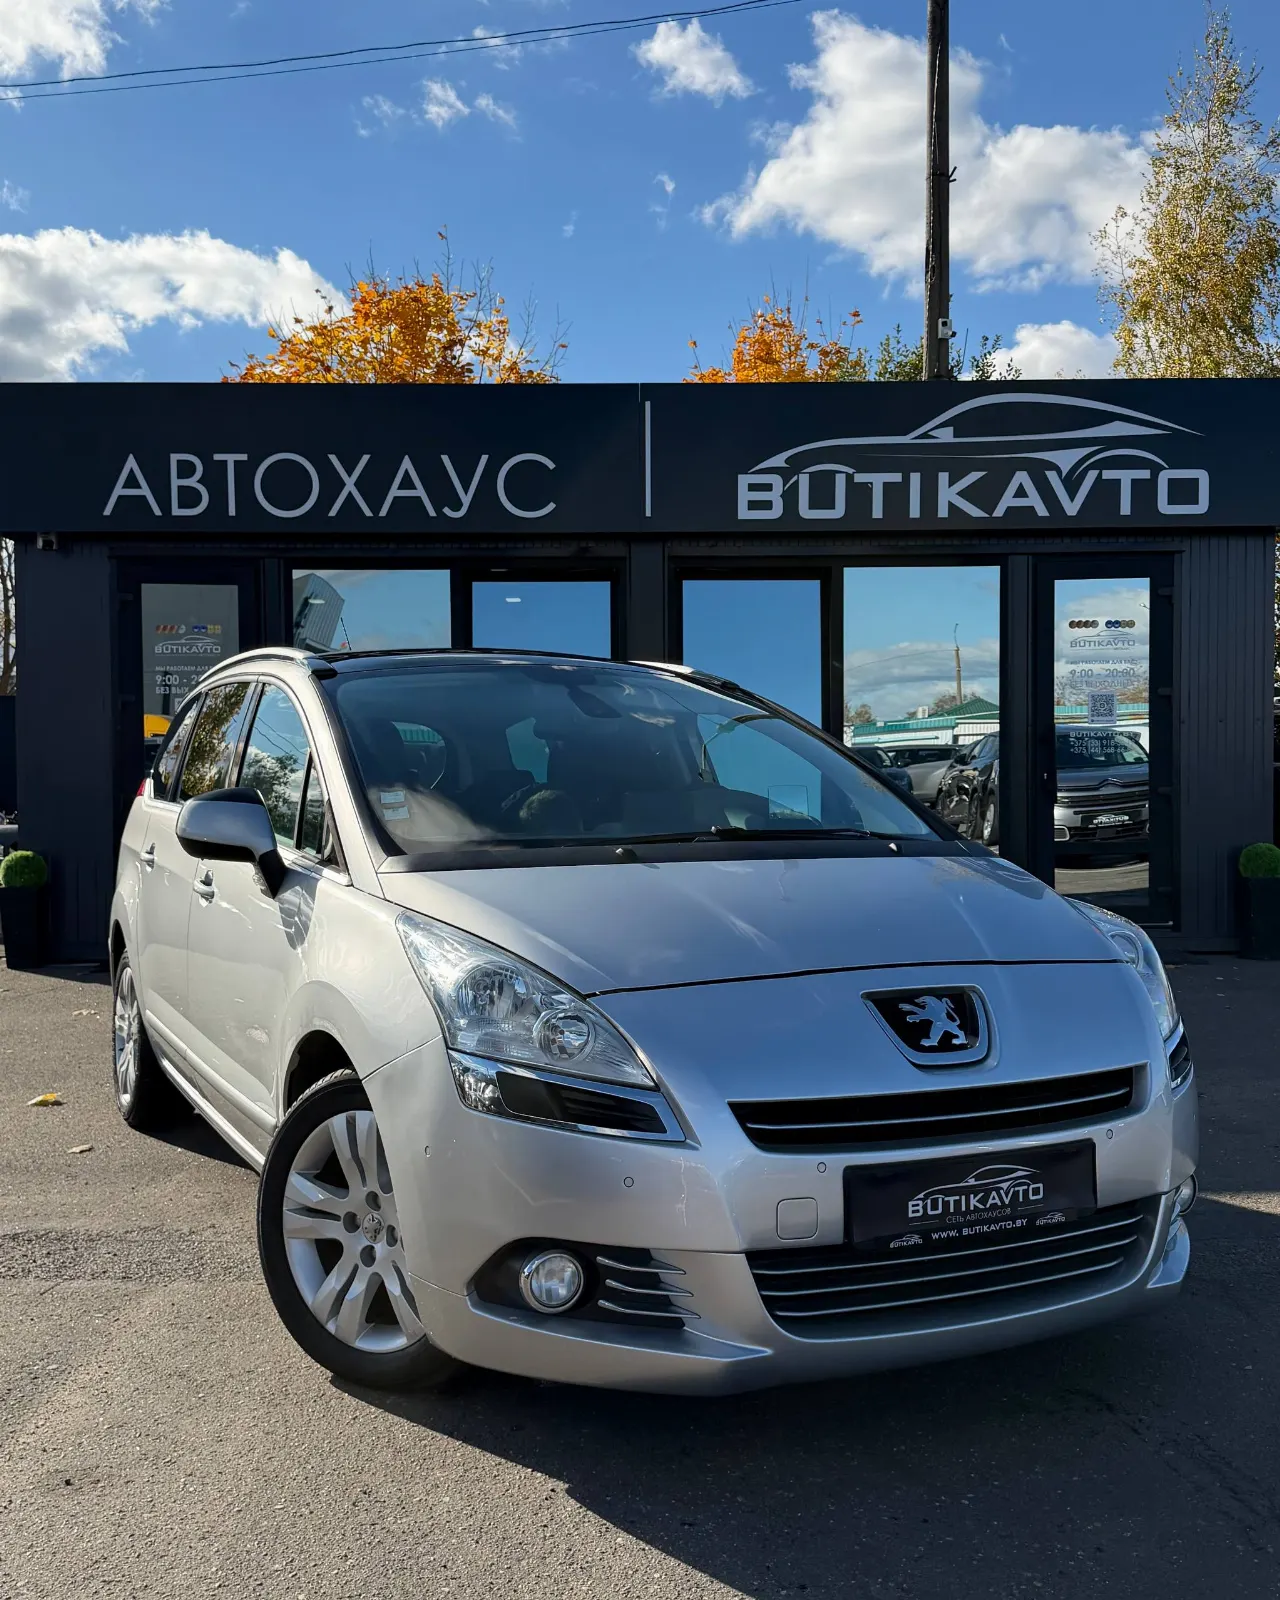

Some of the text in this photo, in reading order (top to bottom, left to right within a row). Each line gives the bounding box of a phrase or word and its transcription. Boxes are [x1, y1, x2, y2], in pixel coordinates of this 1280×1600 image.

[103, 452, 557, 518] АВТОХАУС
[737, 467, 1210, 520] BUTIKAVTO
[1070, 639, 1136, 648] BUTIKAVTO
[154, 645, 221, 654] BUTIKAVTO
[1070, 668, 1094, 679] 9:00
[155, 674, 180, 685] 9:00
[155, 686, 170, 694] БЕЗ
[907, 1182, 1044, 1218] BUTIKAVTO
[945, 1207, 1012, 1224] СЕТЬ АВТОХАУСОВ
[1035, 1216, 1066, 1226] BUTIKAVTO
[931, 1218, 1028, 1240] WWW. BUTIKAVTO.BY
[889, 1239, 923, 1248] BUTIKAVTO
